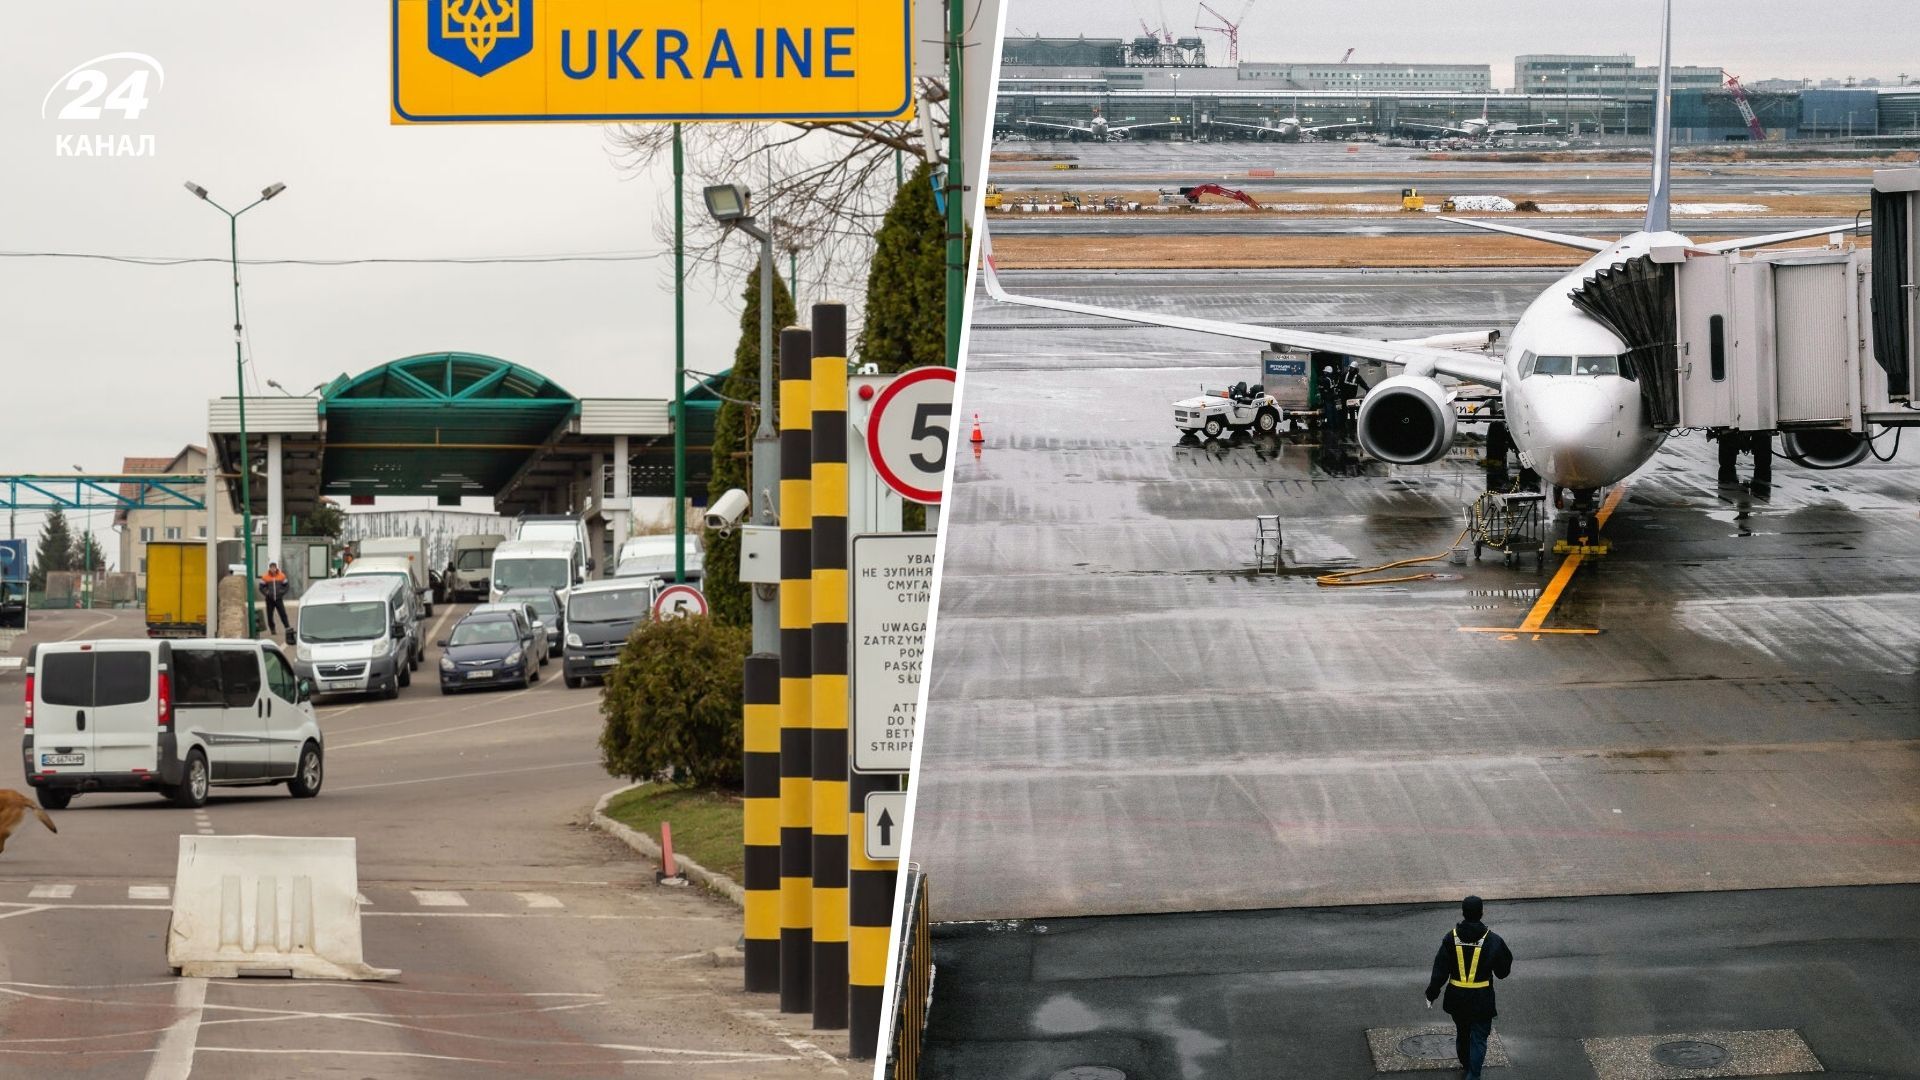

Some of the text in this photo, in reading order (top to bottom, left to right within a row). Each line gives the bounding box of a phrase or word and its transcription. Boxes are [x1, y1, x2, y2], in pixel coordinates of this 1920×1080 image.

[561, 27, 856, 80] UKRAINE
[909, 403, 953, 474] 5
[862, 568, 877, 577] НЕ
[887, 580, 932, 590] СМУГА
[673, 600, 688, 618] 5
[882, 622, 927, 632] UWAGA
[863, 635, 926, 646] ZATRZYM
[893, 703, 918, 713] ATT
[888, 716, 905, 726] DO
